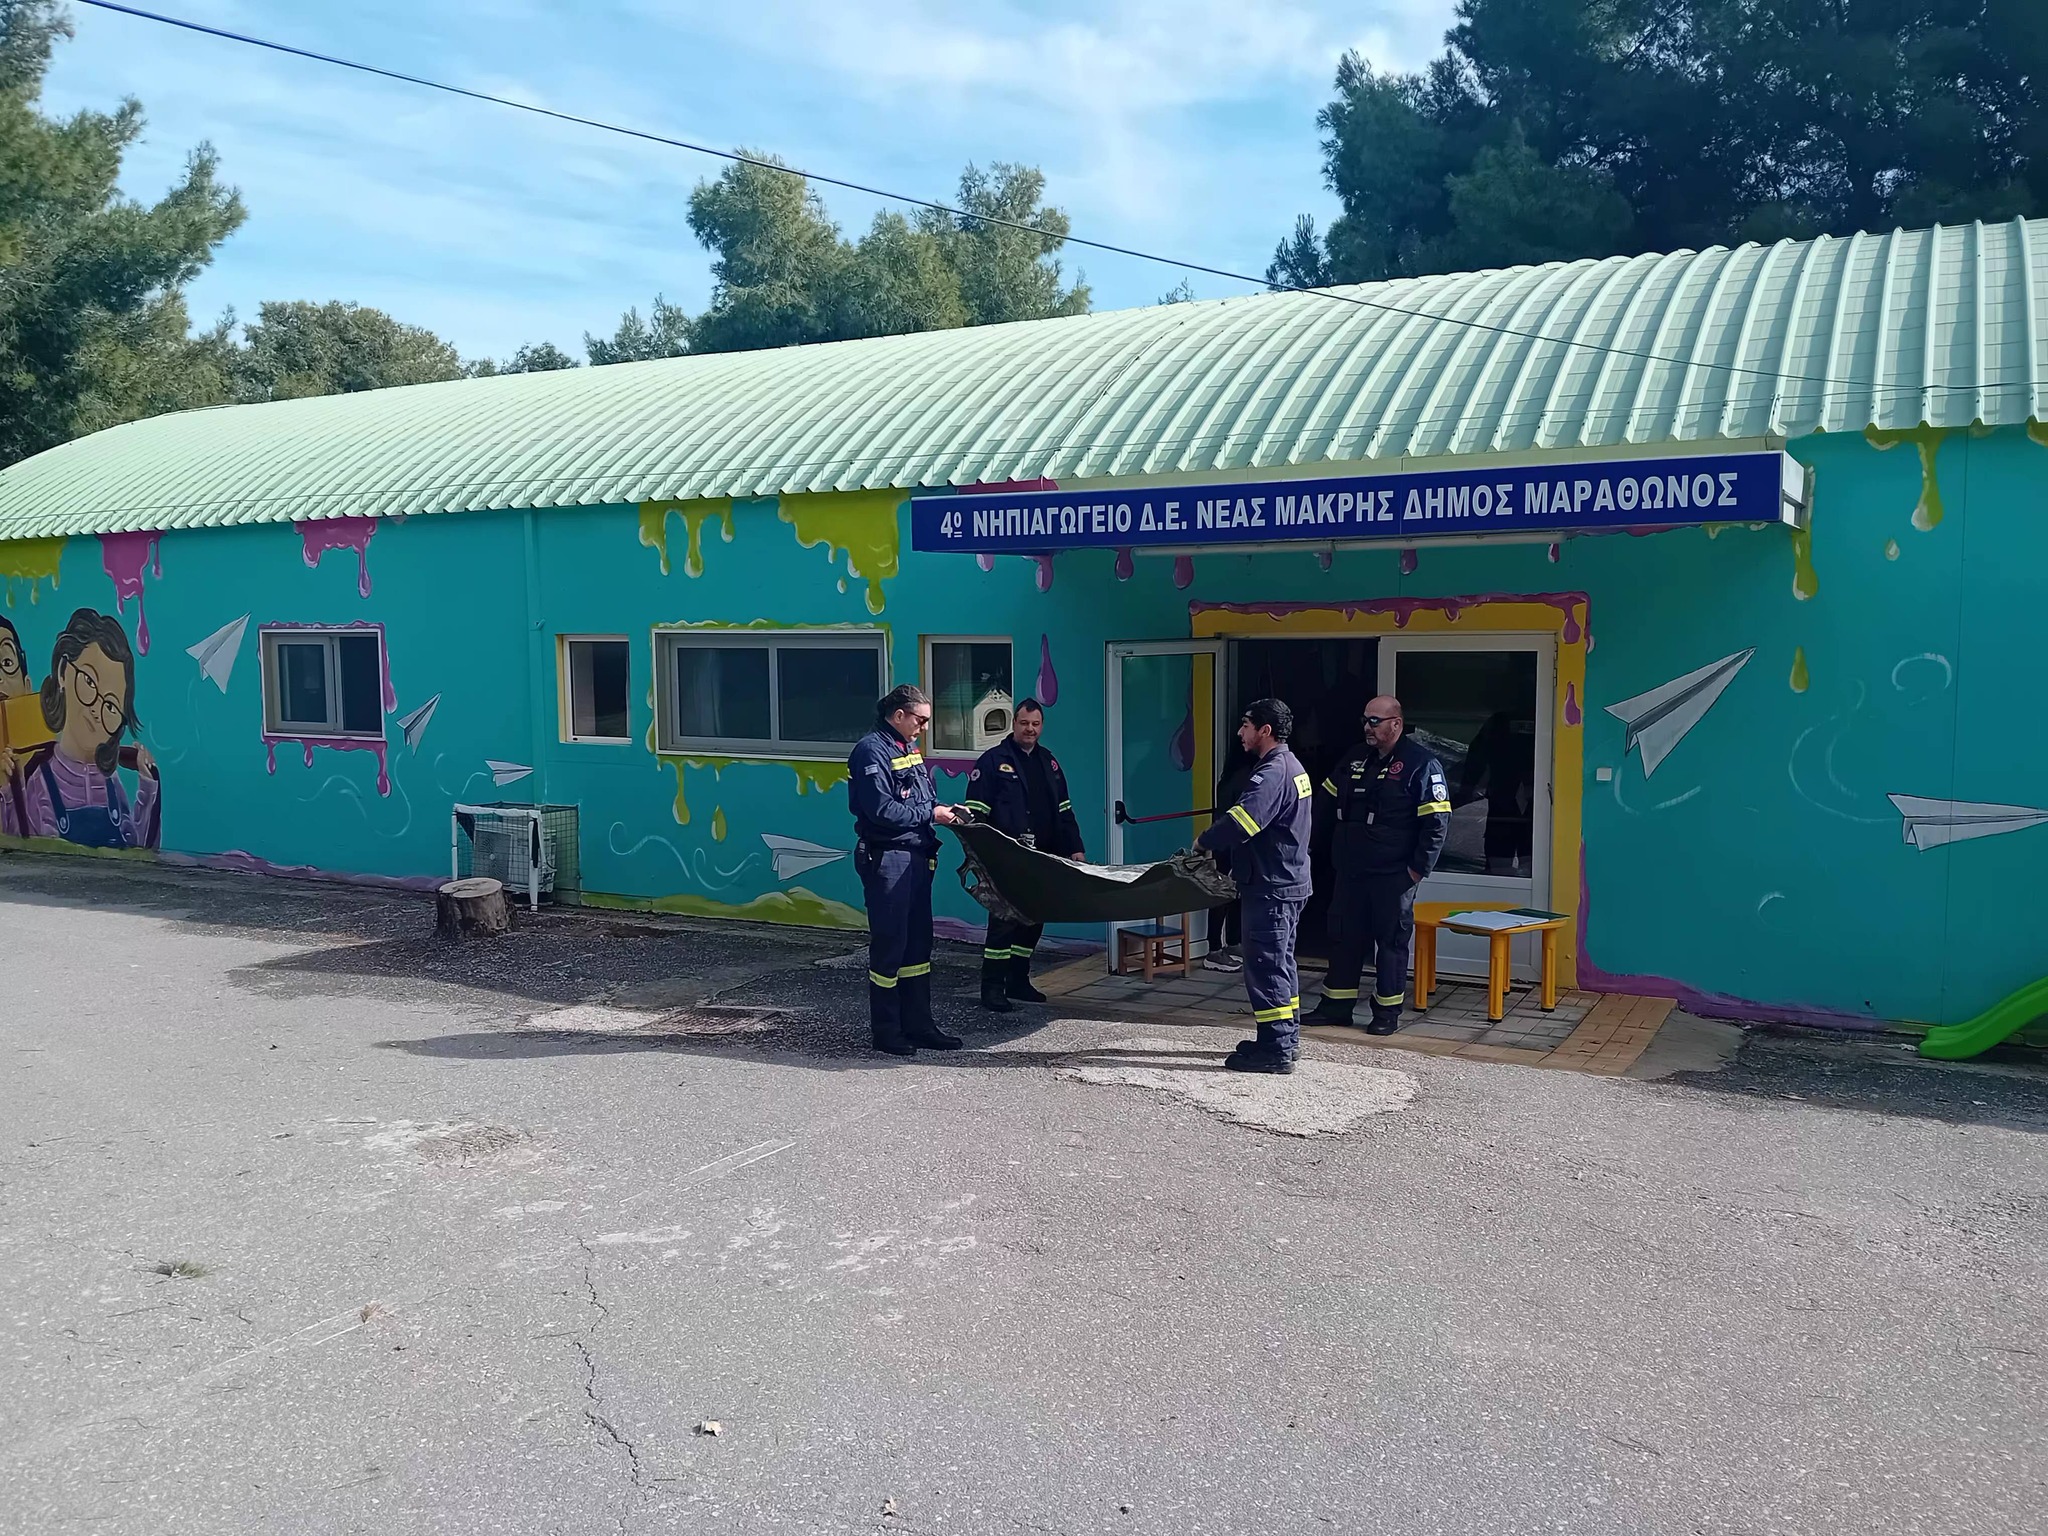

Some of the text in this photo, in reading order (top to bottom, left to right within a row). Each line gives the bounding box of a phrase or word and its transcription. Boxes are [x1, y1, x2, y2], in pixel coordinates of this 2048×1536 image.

[973, 503, 1132, 538] ΝΗΠΙΑΓΩΓΕΙΟ
[1139, 501, 1188, 532] Δ.Ε.
[1196, 497, 1266, 530] ΝΕΑΣ
[1275, 490, 1394, 526] ΜΑΚΡΗΣ
[1402, 483, 1514, 520] ΔΗΜΟΣ
[1524, 472, 1738, 515] ΜΑΡΑΘΩΝΟΣ
